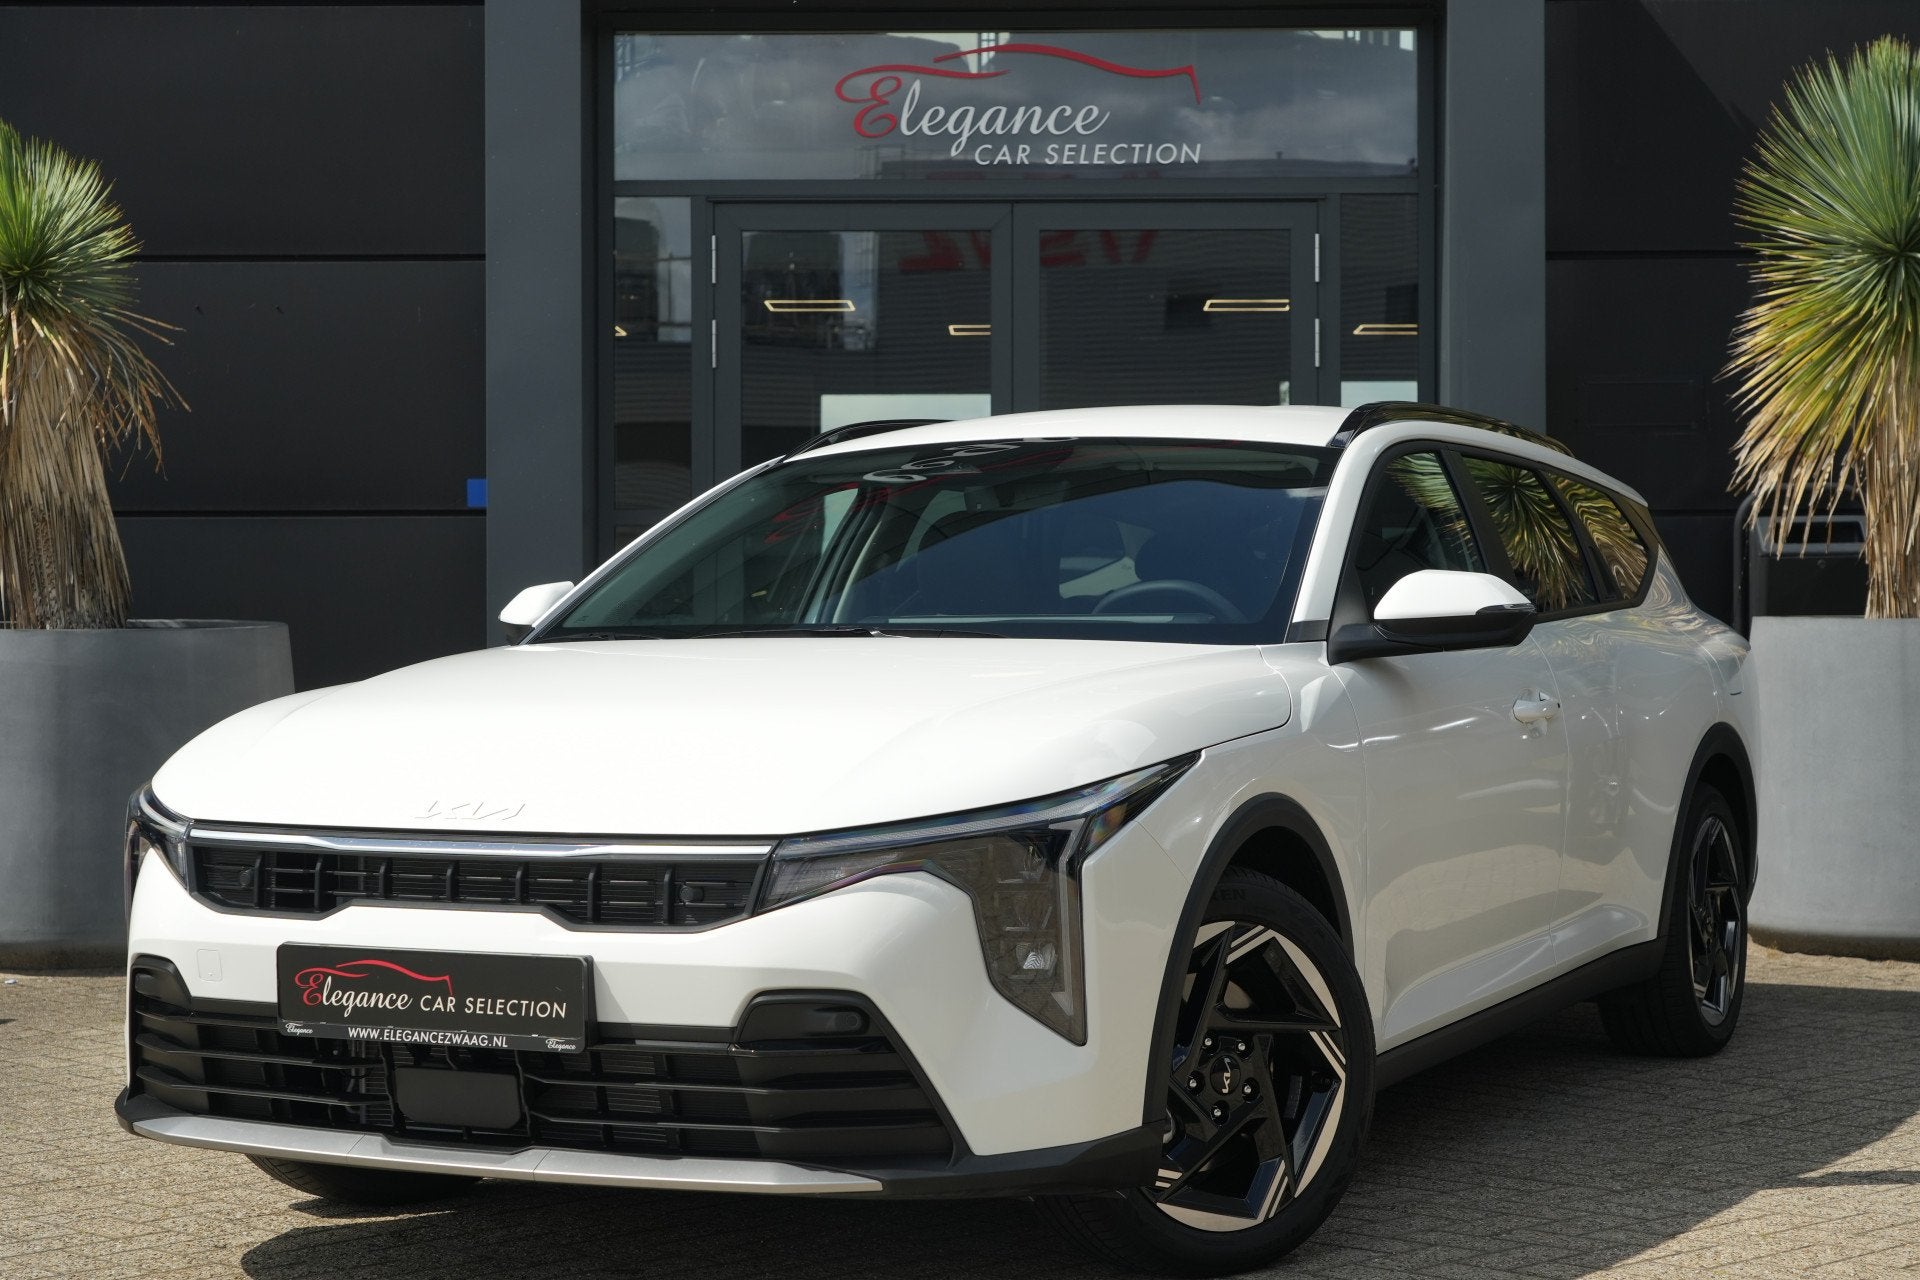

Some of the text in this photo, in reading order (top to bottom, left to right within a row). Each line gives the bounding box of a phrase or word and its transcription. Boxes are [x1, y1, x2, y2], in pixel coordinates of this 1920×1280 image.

[835, 64, 1110, 157] Elegance
[974, 143, 1201, 165] CAR SELECTION
[295, 967, 567, 1019] Elegance CAR SELECTION
[348, 1027, 508, 1048] WWW.ELEGANCEZWAAG.NL
